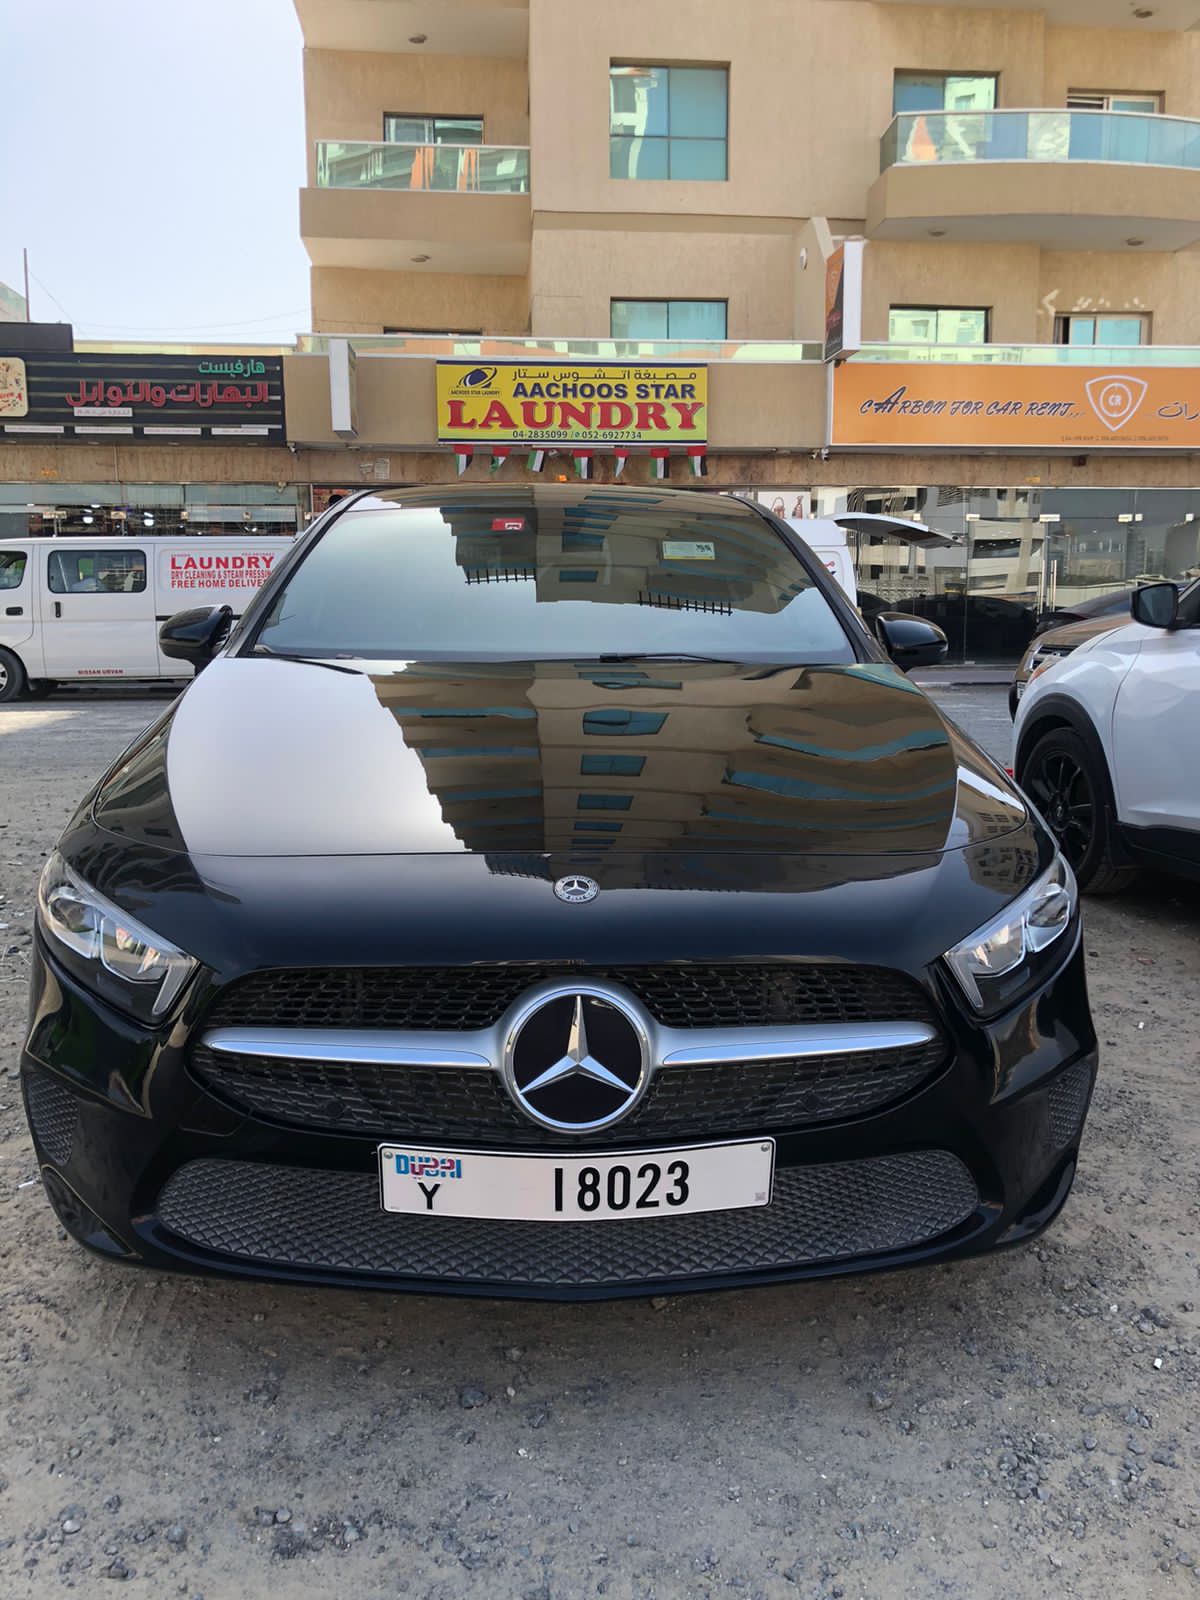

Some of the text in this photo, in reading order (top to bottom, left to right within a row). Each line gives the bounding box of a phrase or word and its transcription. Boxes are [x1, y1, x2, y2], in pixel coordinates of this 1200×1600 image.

[198, 359, 265, 377] هارفيست
[512, 382, 696, 399] AACHOOS STAR
[859, 386, 947, 415] CARBON
[949, 400, 983, 416] FOR
[985, 400, 1024, 416] CAR
[446, 400, 705, 431] LAUNDRY
[171, 556, 274, 569] LAUNDRY
[171, 571, 183, 579] DRY
[184, 570, 216, 579] CLEANING
[223, 570, 244, 579] STEAM
[171, 580, 196, 588] FREE
[198, 580, 226, 588] HOME
[417, 1161, 690, 1212] Y 18023
